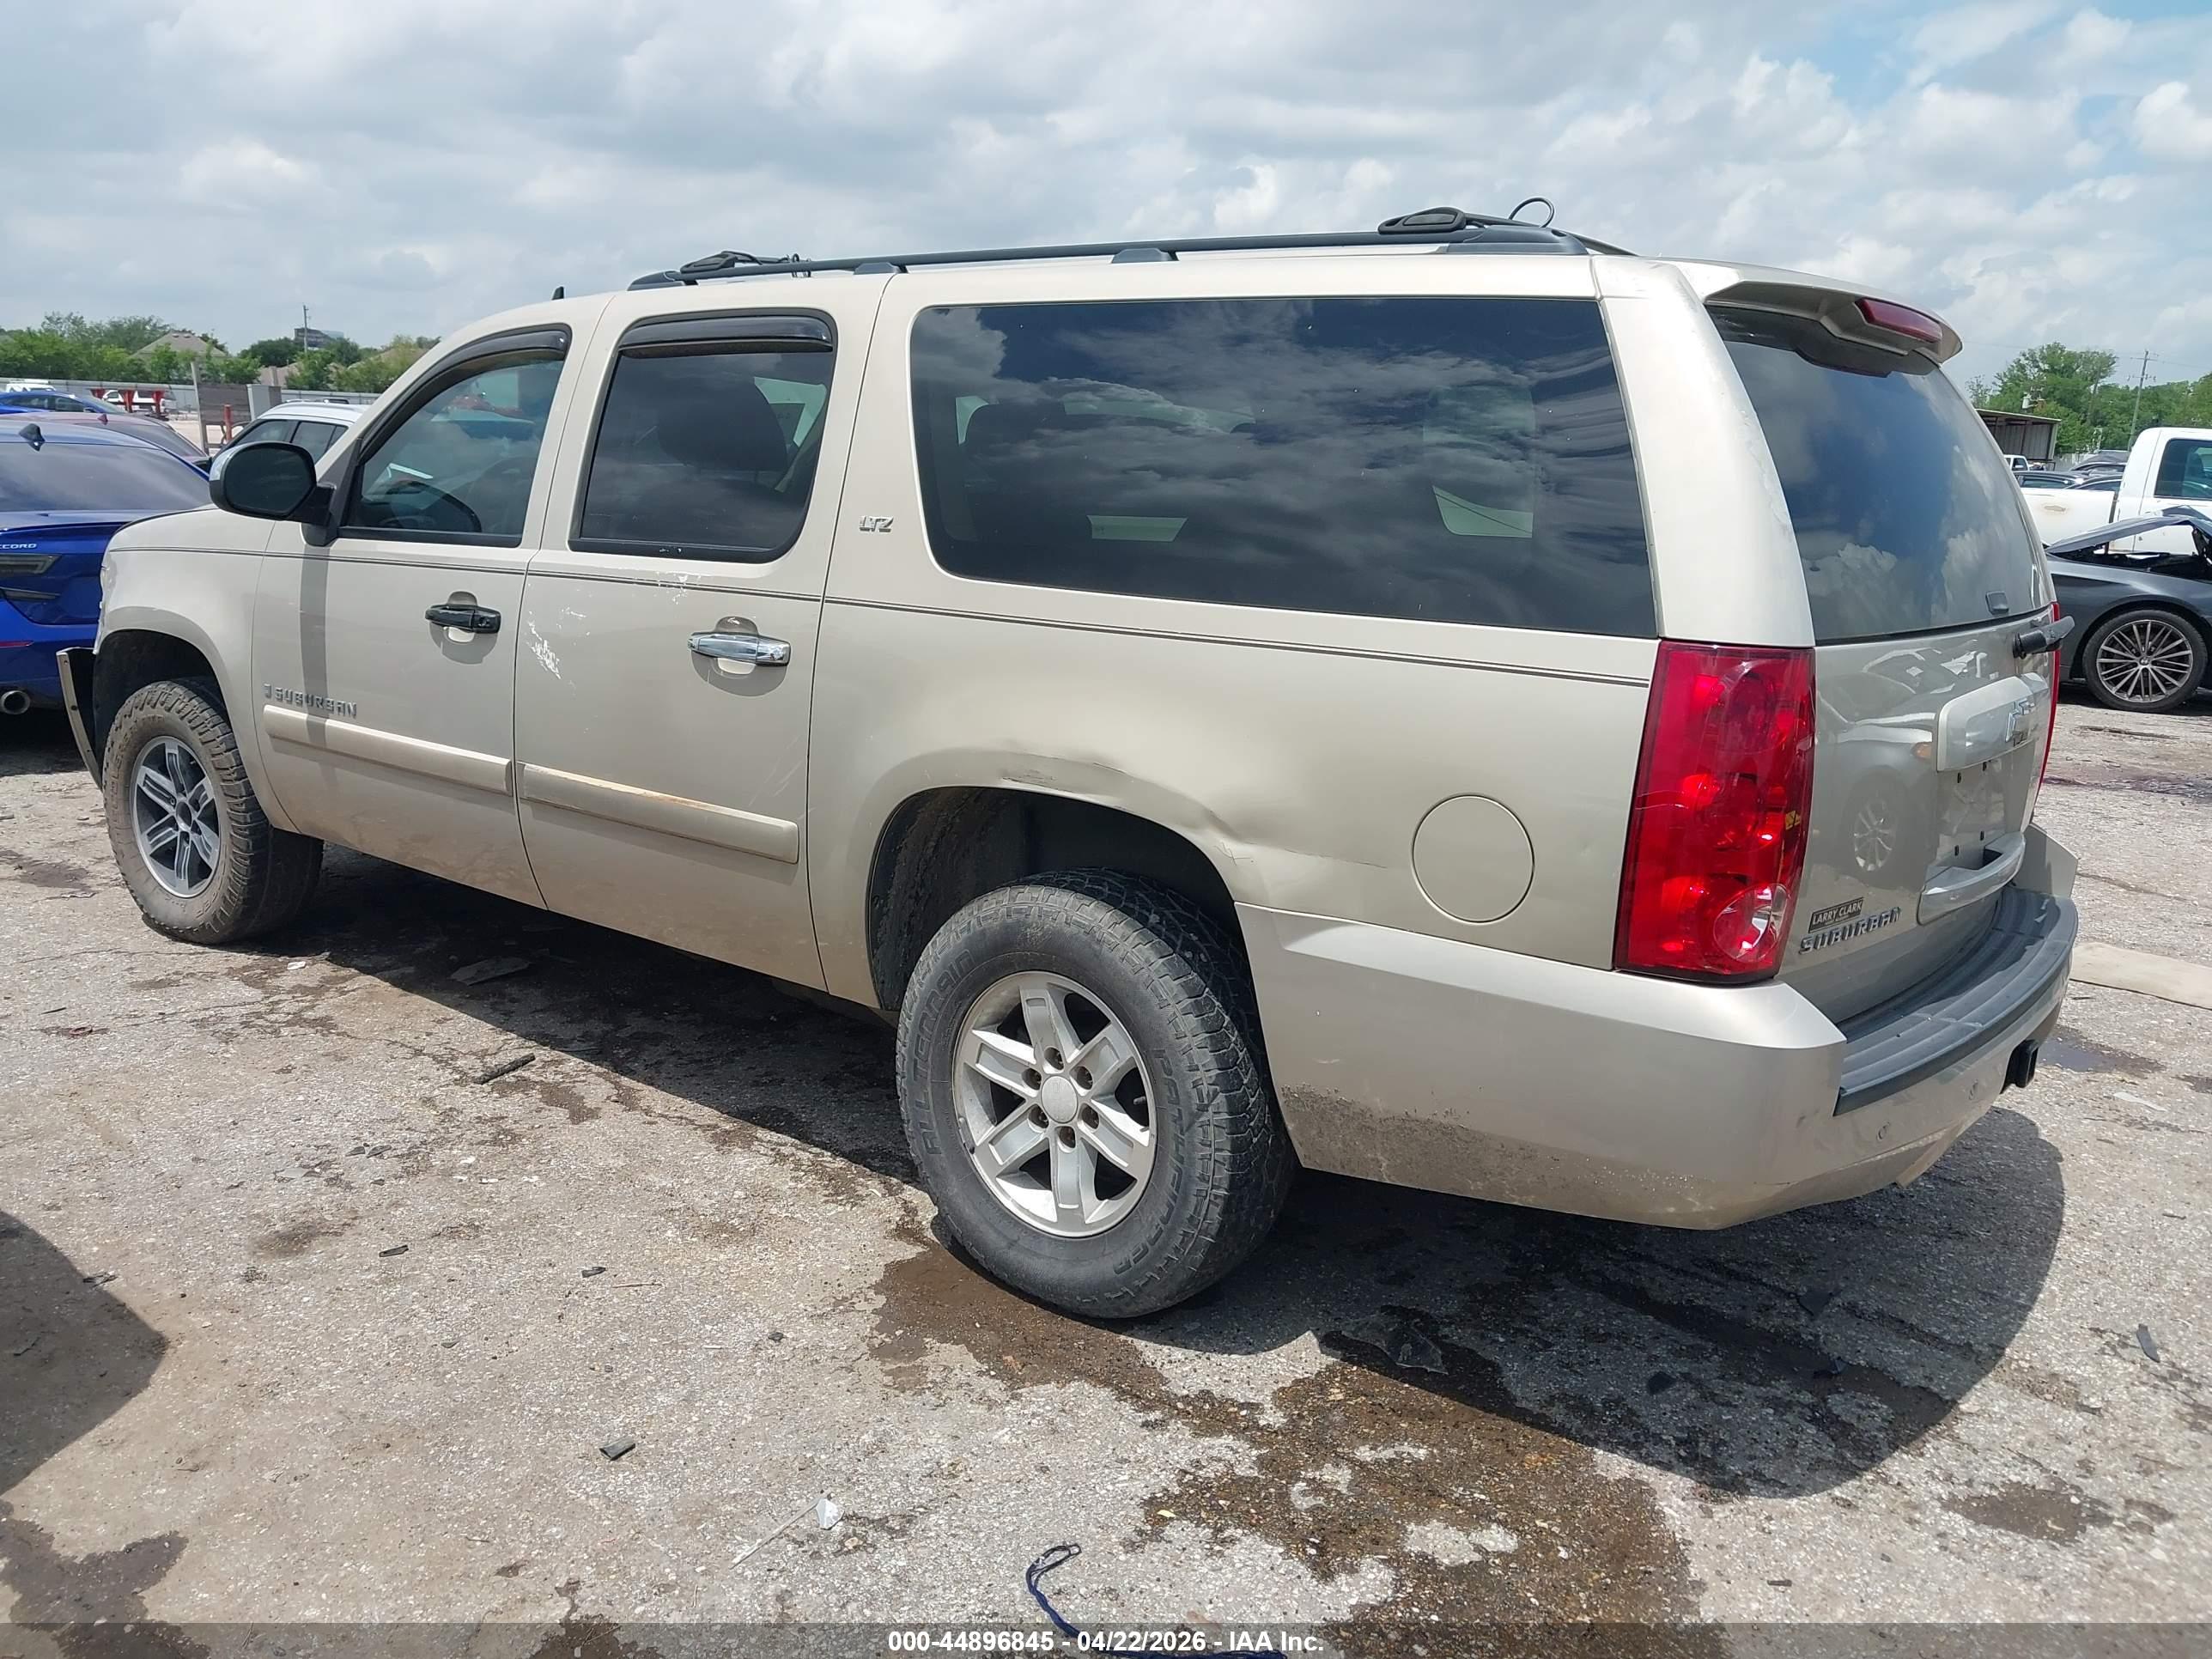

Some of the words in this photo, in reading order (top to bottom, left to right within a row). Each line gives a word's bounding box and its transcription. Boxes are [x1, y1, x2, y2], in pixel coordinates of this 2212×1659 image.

[859, 516, 894, 532] LTZ
[275, 687, 356, 719] SUBURBAN
[1798, 906, 1901, 955] SUBURBAN
[1813, 908, 1838, 925] LARRY
[1838, 900, 1863, 917] CLARK
[914, 949, 976, 1082] TERRAIN
[915, 1089, 943, 1155] ALL
